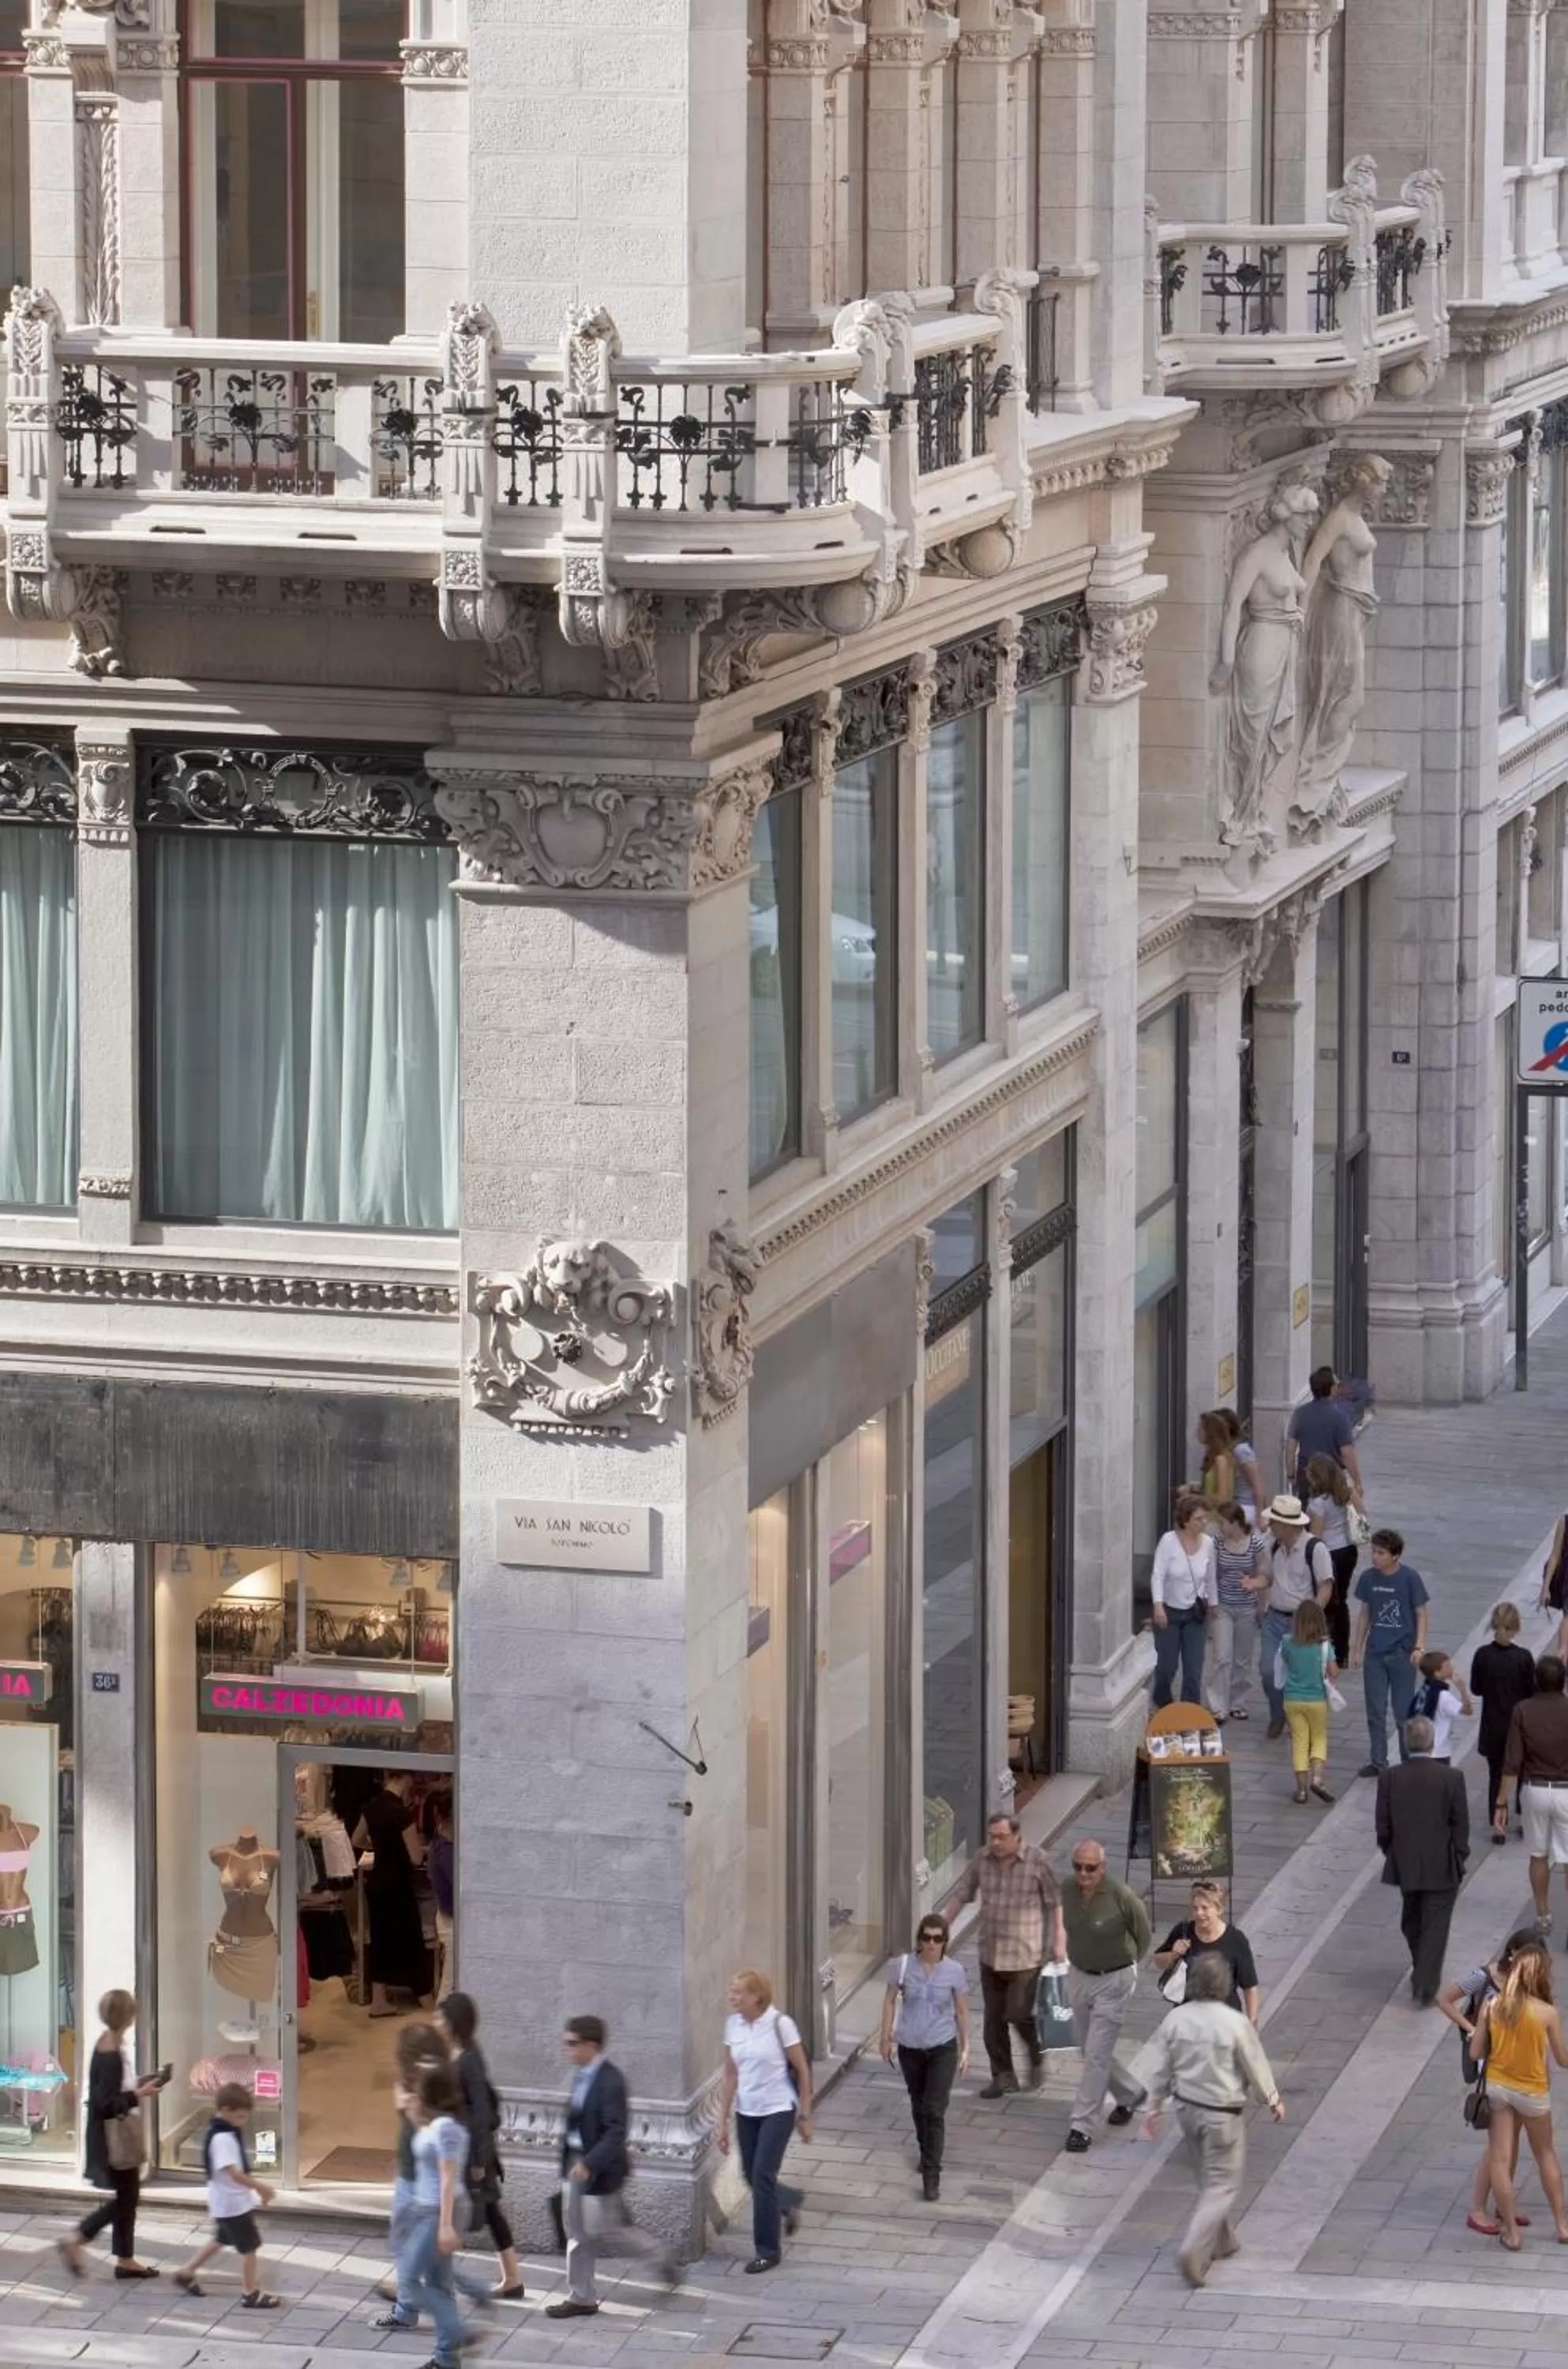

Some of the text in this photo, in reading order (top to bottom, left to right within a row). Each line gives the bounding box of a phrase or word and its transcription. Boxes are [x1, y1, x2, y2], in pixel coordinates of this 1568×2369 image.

[514, 1515, 537, 1529] VIA
[546, 1517, 571, 1531] SAN
[212, 1684, 404, 1720] CALZEDONIA
